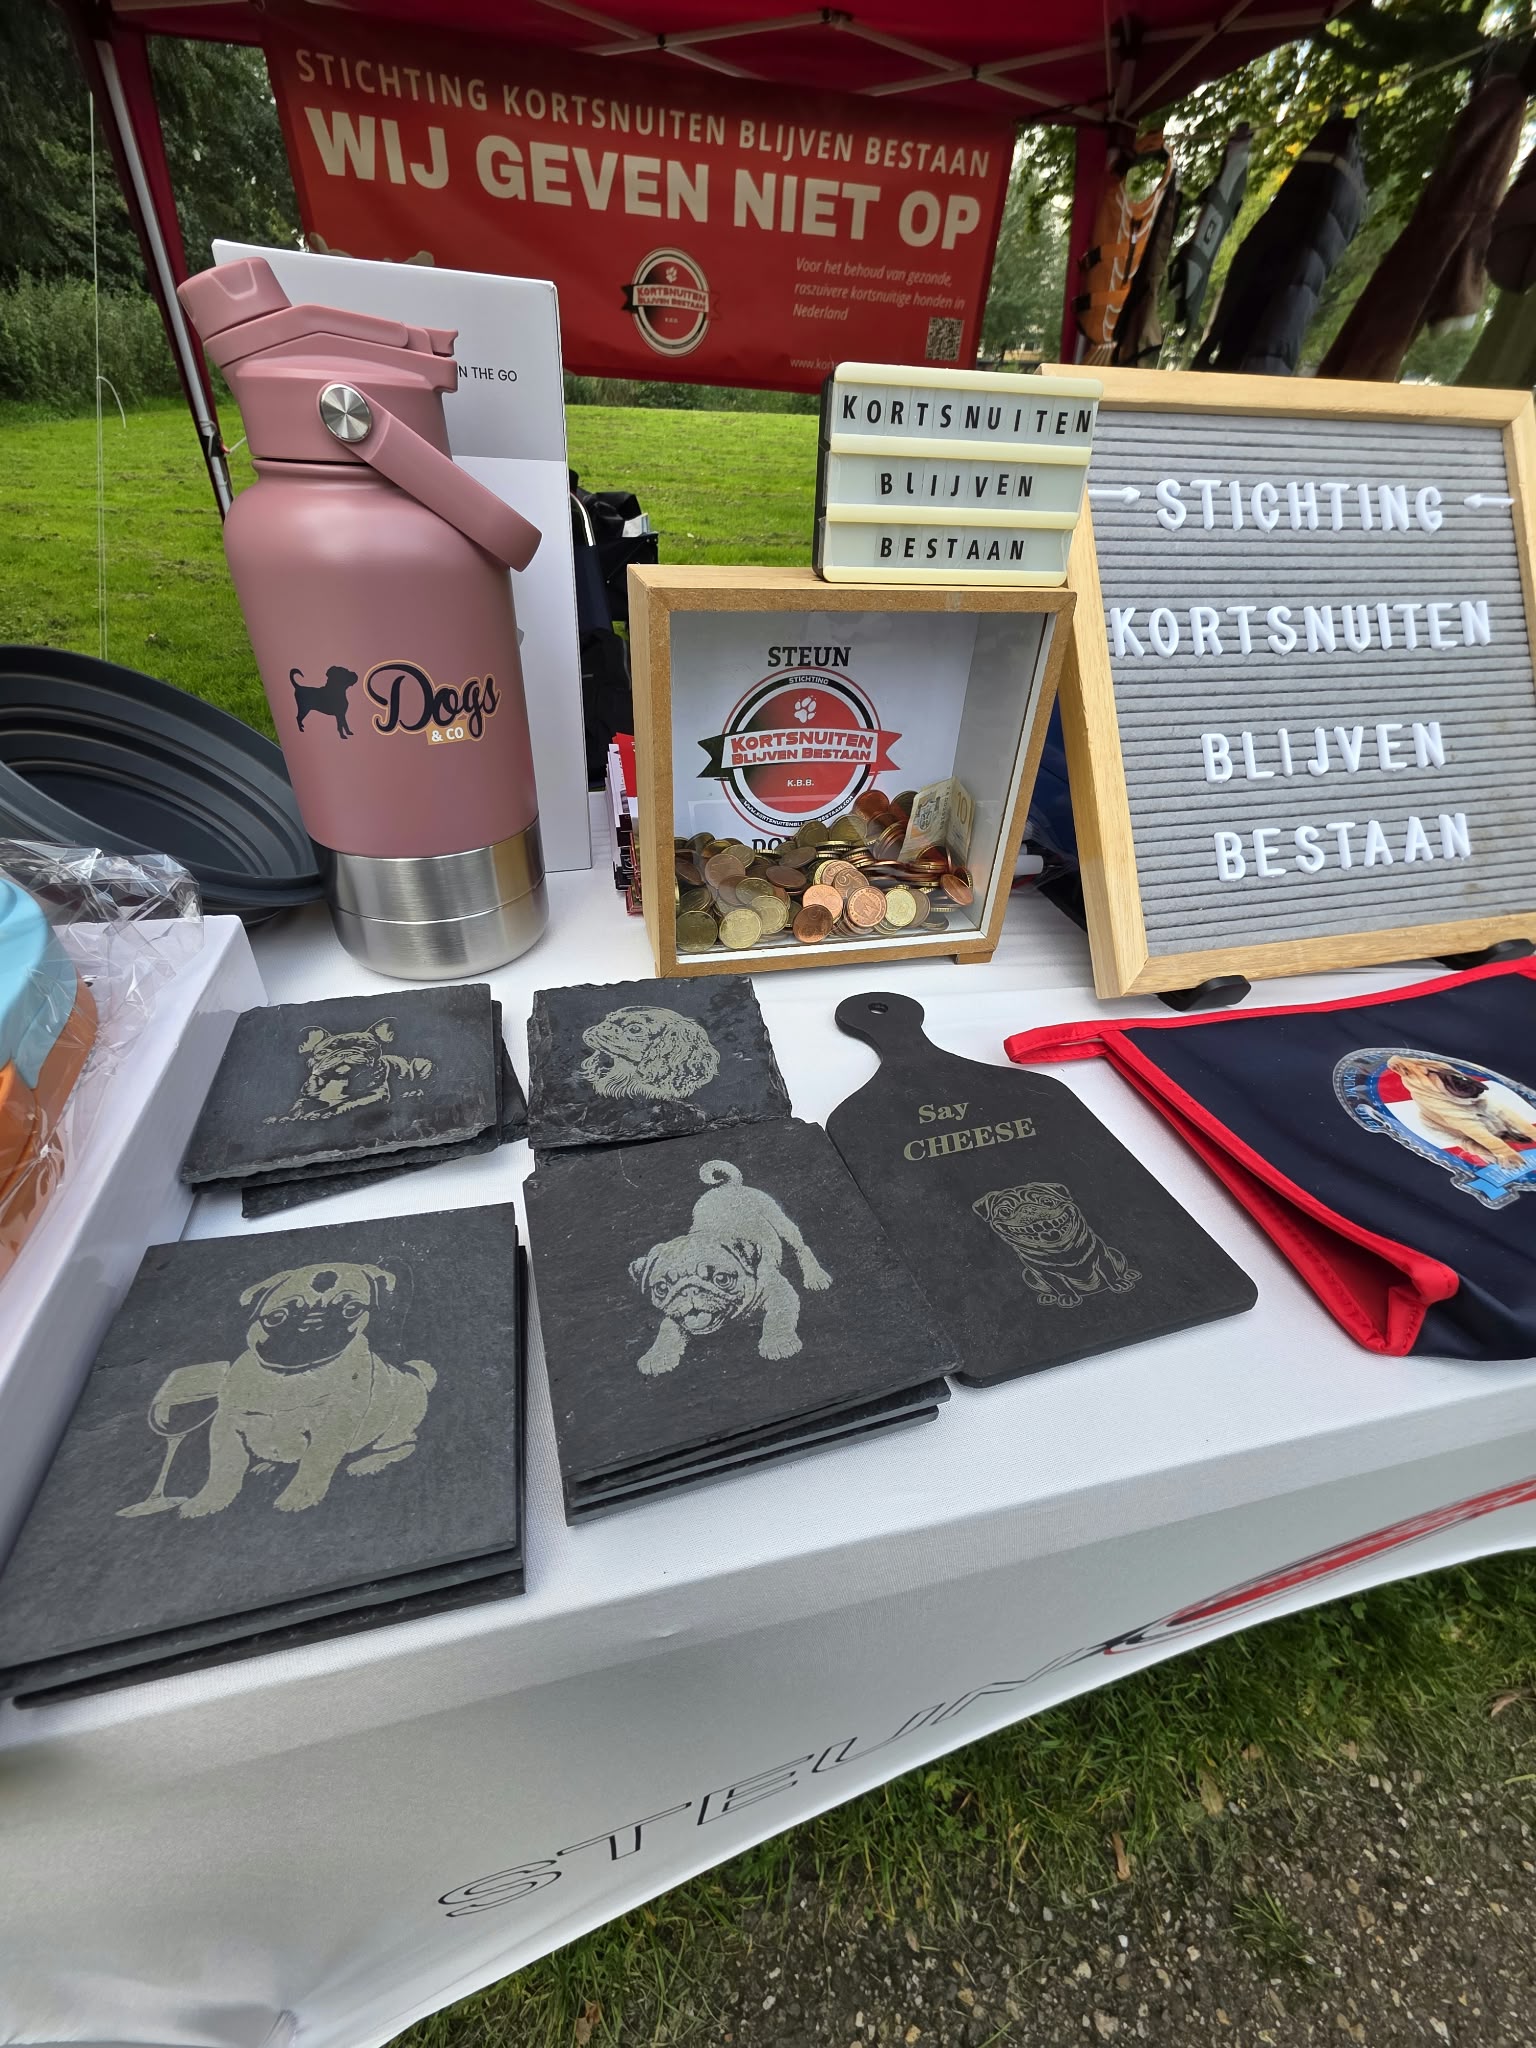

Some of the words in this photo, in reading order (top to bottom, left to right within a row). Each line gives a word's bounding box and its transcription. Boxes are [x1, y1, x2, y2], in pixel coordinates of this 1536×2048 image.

[295, 49, 487, 111] STICHTING
[503, 84, 725, 145] KORTSNUITEN
[739, 119, 853, 162] BLIJVEN
[865, 137, 990, 178] BESTAAN
[304, 106, 450, 189] WIJ
[476, 135, 709, 223] GEVEN
[734, 168, 881, 240] NIET
[899, 190, 981, 250] OP
[796, 257, 821, 273] Voor
[824, 260, 841, 275] het
[844, 263, 885, 280] behoud
[886, 269, 905, 281] van
[794, 283, 849, 299] raszuivere
[913, 292, 953, 308] honden
[954, 296, 965, 310] in
[793, 304, 848, 321] Nederland
[471, 366, 494, 380] THE
[498, 369, 518, 382] GO
[842, 395, 1091, 435] KORTSNUITEN
[1155, 478, 1444, 534] STICHTING
[880, 537, 1024, 561] BESTAAN
[1109, 600, 1492, 660] KORTSNUITEN
[767, 646, 851, 668] STEUN
[788, 675, 829, 685] STICHTING
[365, 661, 501, 740] Dogs
[431, 729, 443, 743] &
[446, 727, 464, 741] CO
[731, 731, 874, 754] KORTSNUITEN
[731, 750, 798, 766] BLIJVEN
[801, 747, 872, 761] BESTAAN
[1201, 721, 1446, 784] BLIJVEN
[787, 779, 815, 787] K.B.B.
[1213, 812, 1472, 883] BESTAAN
[918, 1101, 970, 1124] Say
[903, 1117, 1037, 1161] CHEESE
